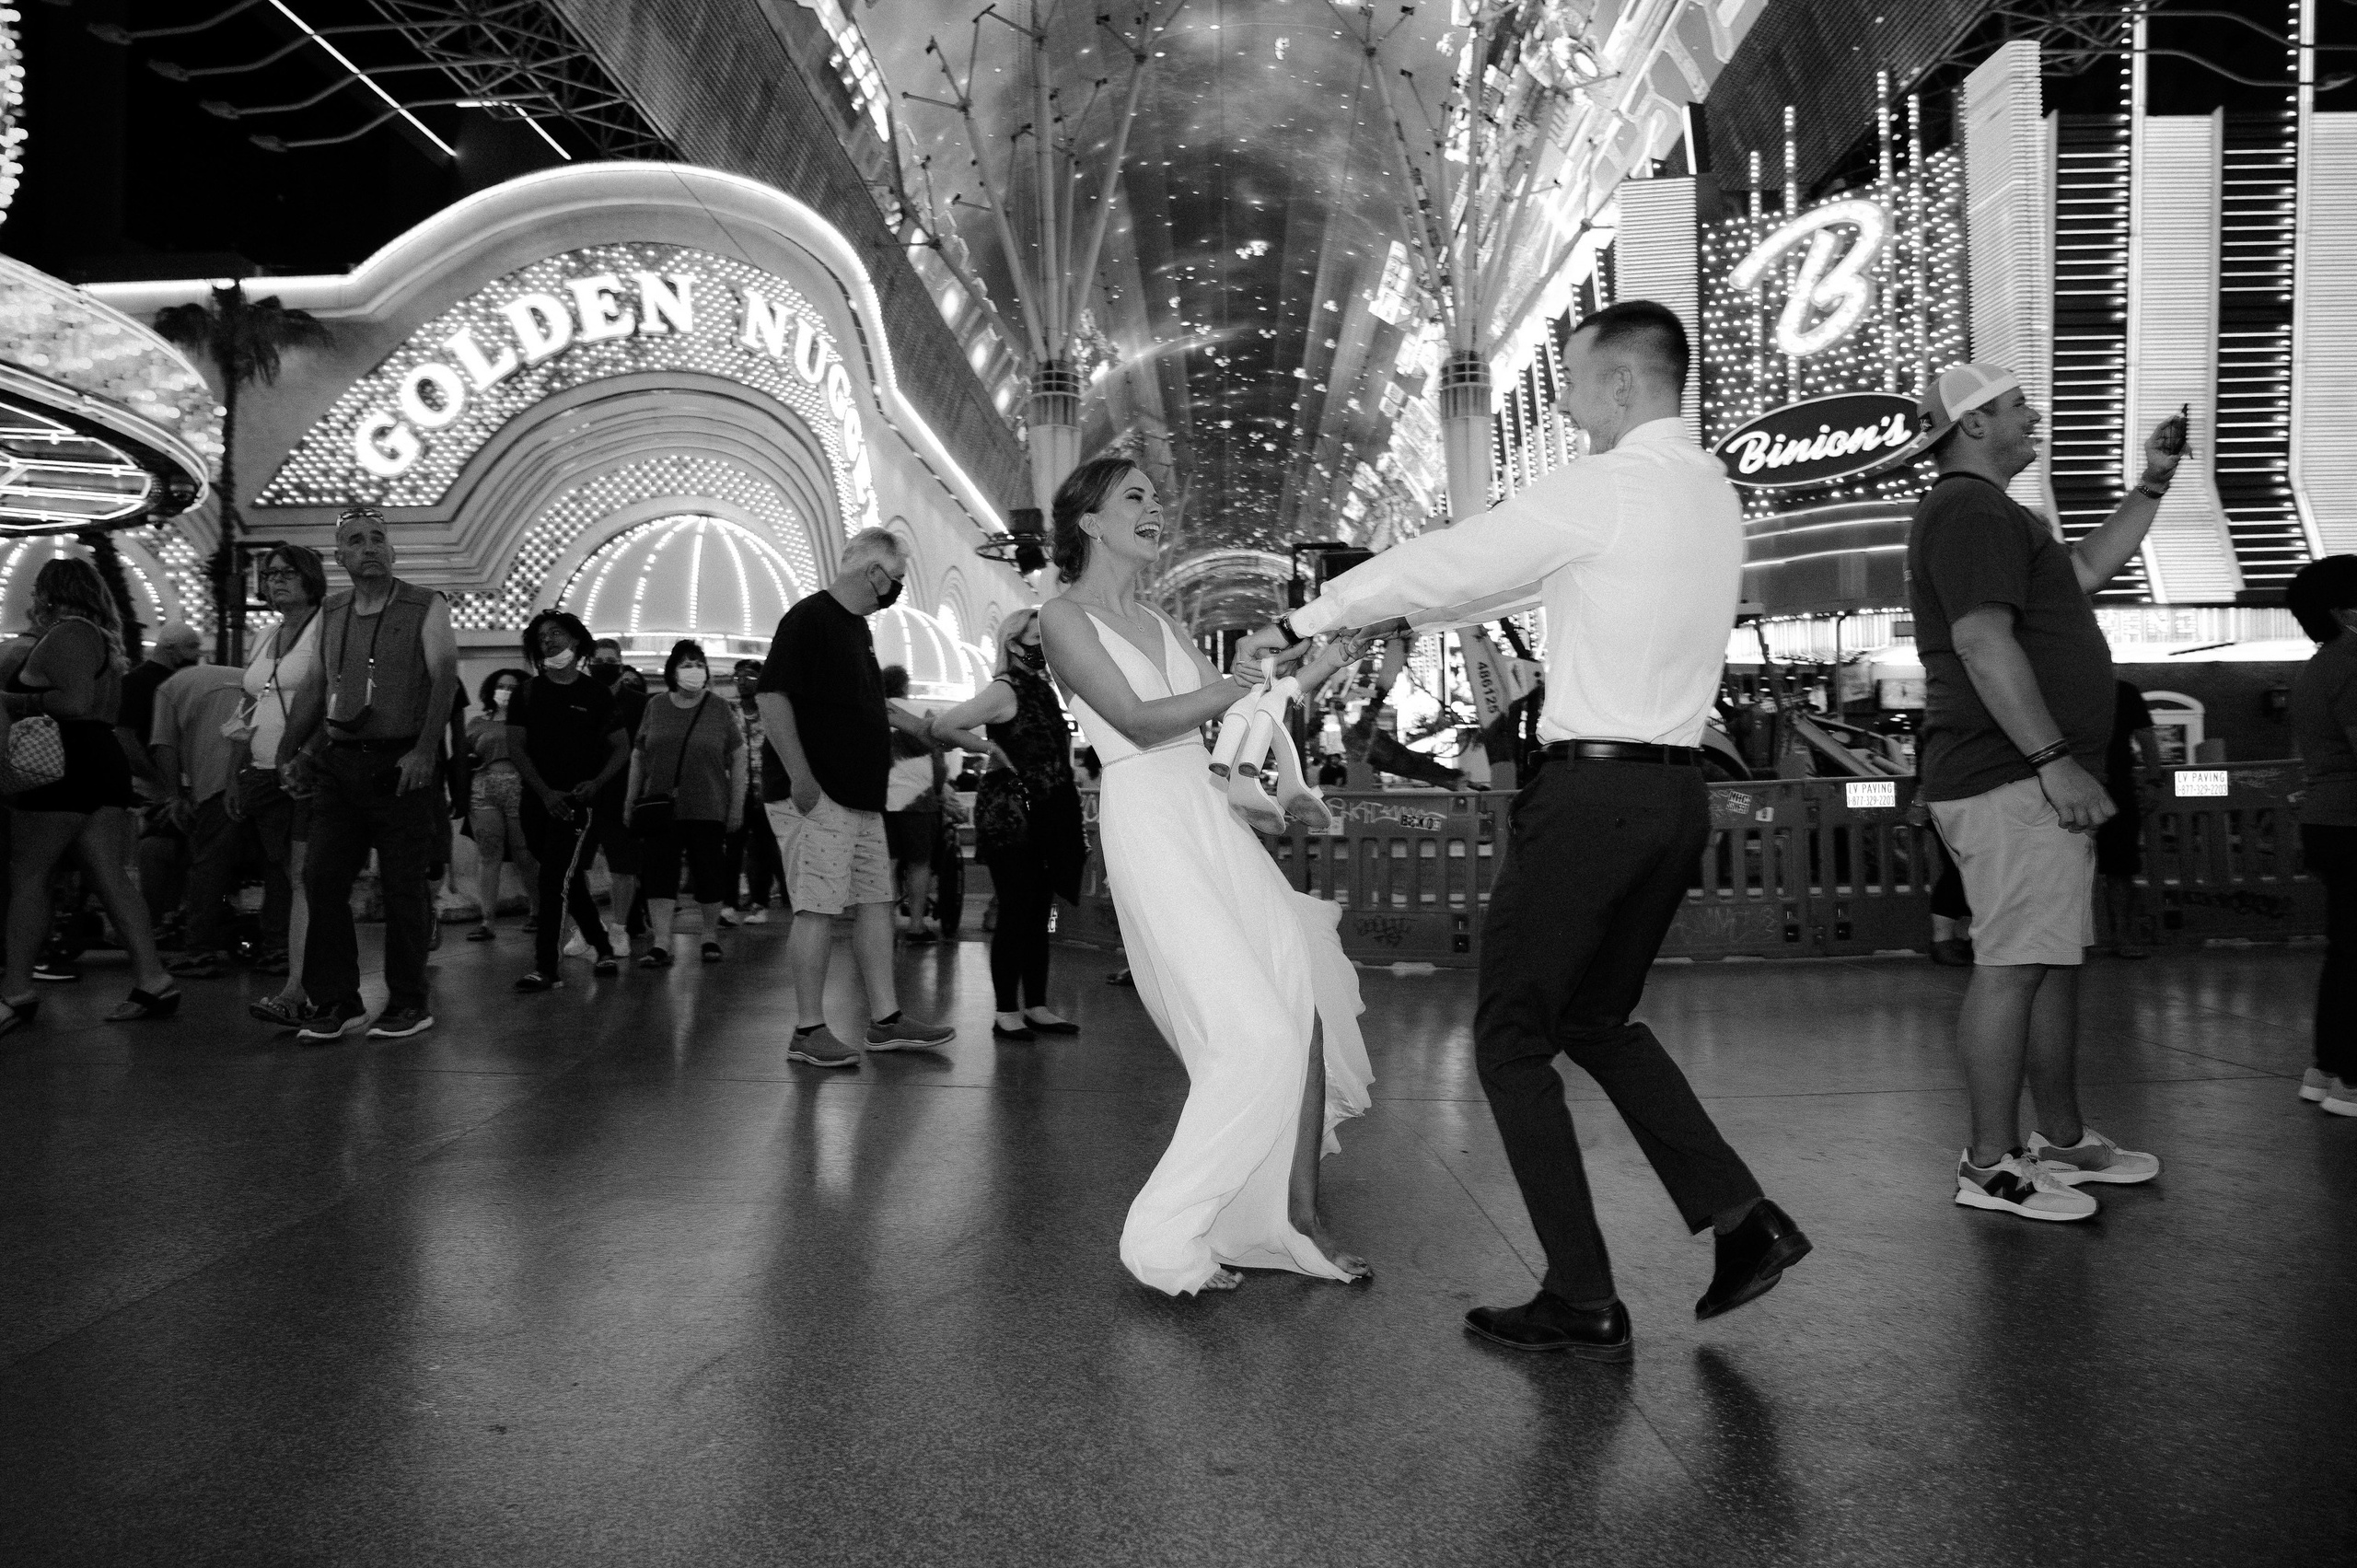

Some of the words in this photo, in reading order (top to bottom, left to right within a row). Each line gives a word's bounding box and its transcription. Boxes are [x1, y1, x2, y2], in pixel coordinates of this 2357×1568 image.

[1728, 200, 1886, 356] B
[354, 273, 696, 476] GOLDEN
[1726, 413, 1911, 474] Binion's
[1849, 784, 1857, 794] LV
[1862, 783, 1892, 793] PAVING
[2178, 772, 2188, 783] LV
[2192, 772, 2224, 783] PAVING
[1848, 796, 1895, 806] 1-877-329-2203
